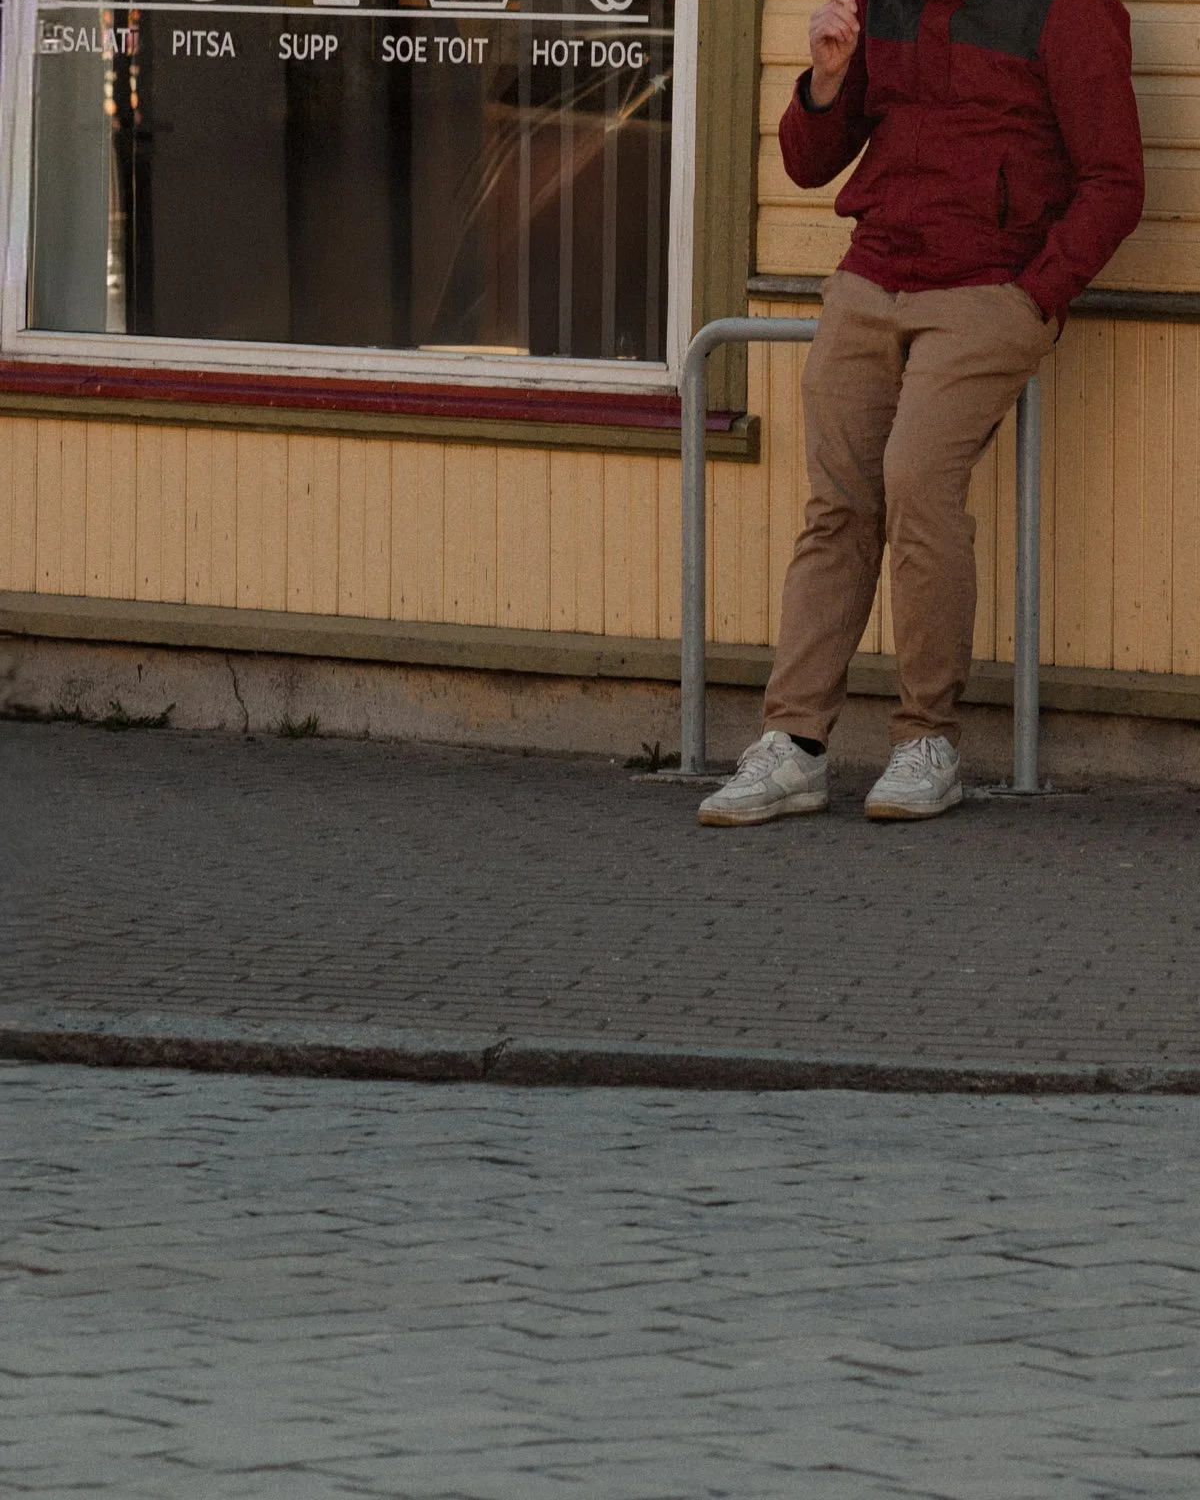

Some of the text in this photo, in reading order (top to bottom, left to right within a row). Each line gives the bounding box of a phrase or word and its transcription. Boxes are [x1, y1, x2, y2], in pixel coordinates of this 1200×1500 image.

[171, 29, 236, 58] PITSA
[278, 33, 339, 61] SUPP
[381, 35, 489, 64] SOE TOIT
[532, 39, 644, 69] HOT DOG
